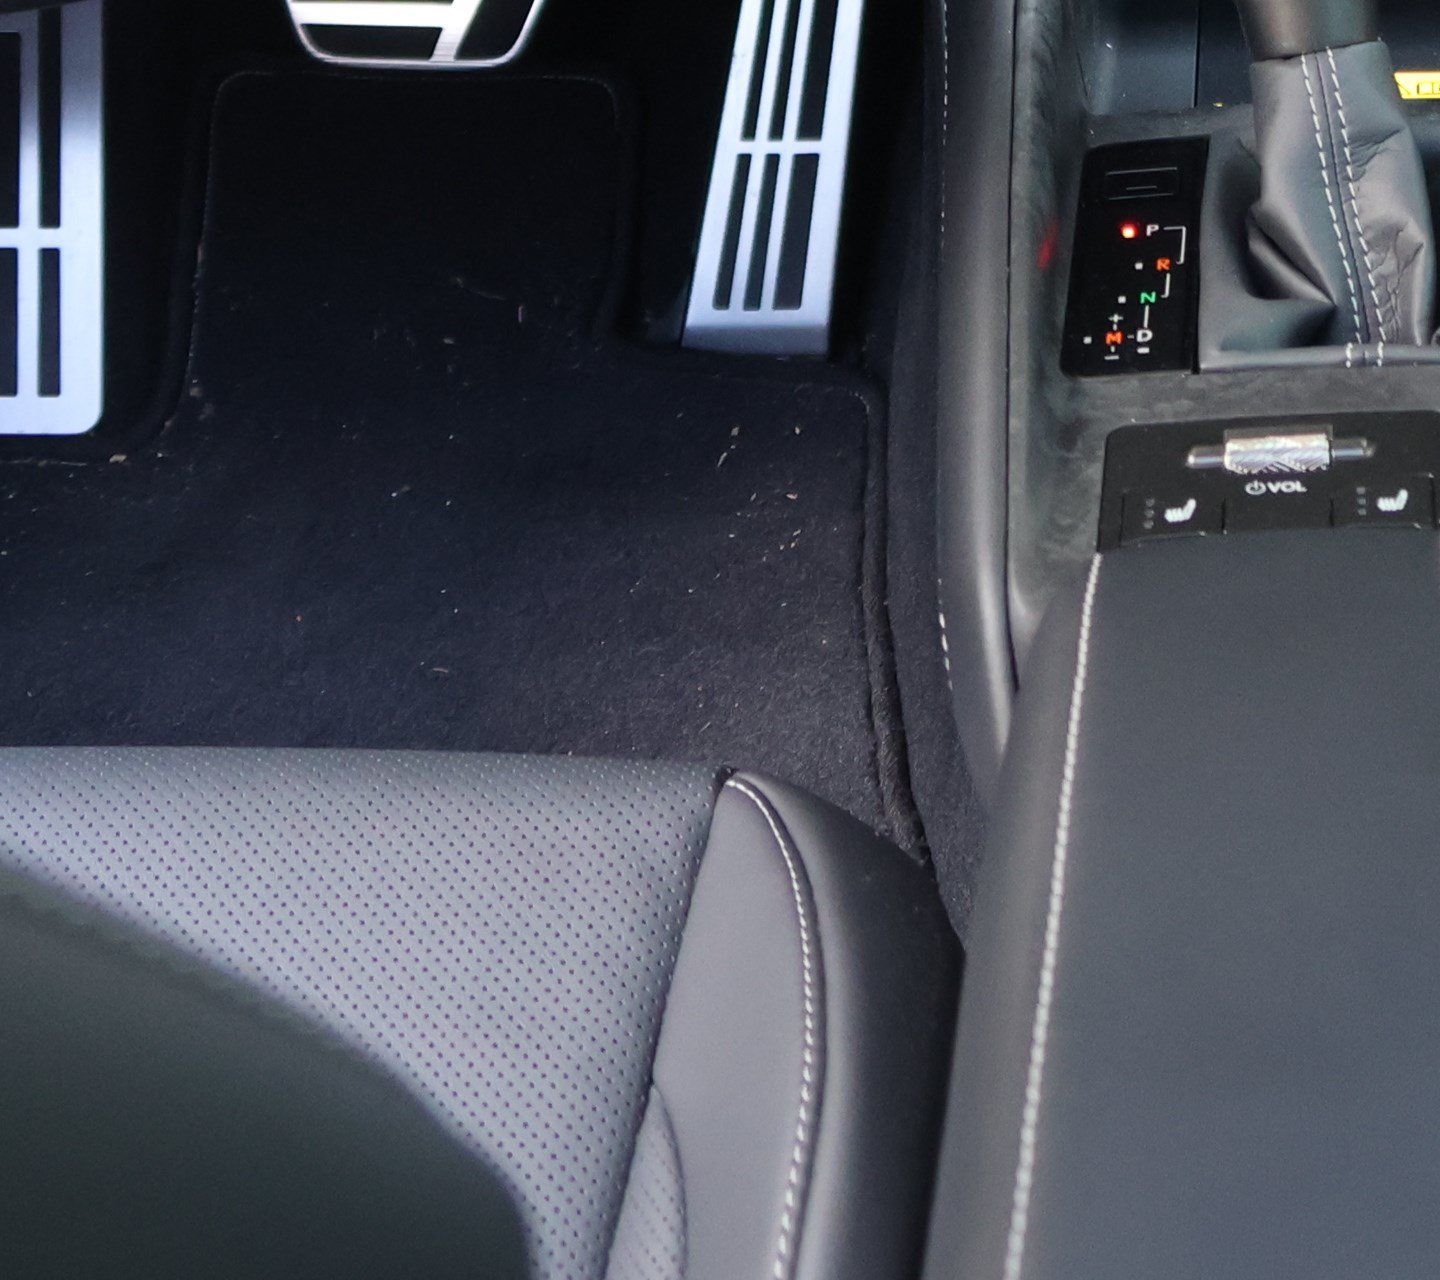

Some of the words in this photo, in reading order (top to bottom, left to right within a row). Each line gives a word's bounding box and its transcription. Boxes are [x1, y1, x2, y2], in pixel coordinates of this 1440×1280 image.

[1146, 224, 1160, 237] P
[1156, 257, 1171, 271] R
[1140, 291, 1157, 304] N
[1105, 330, 1123, 345] M
[1136, 329, 1154, 342] D
[1266, 480, 1308, 493] VOL
